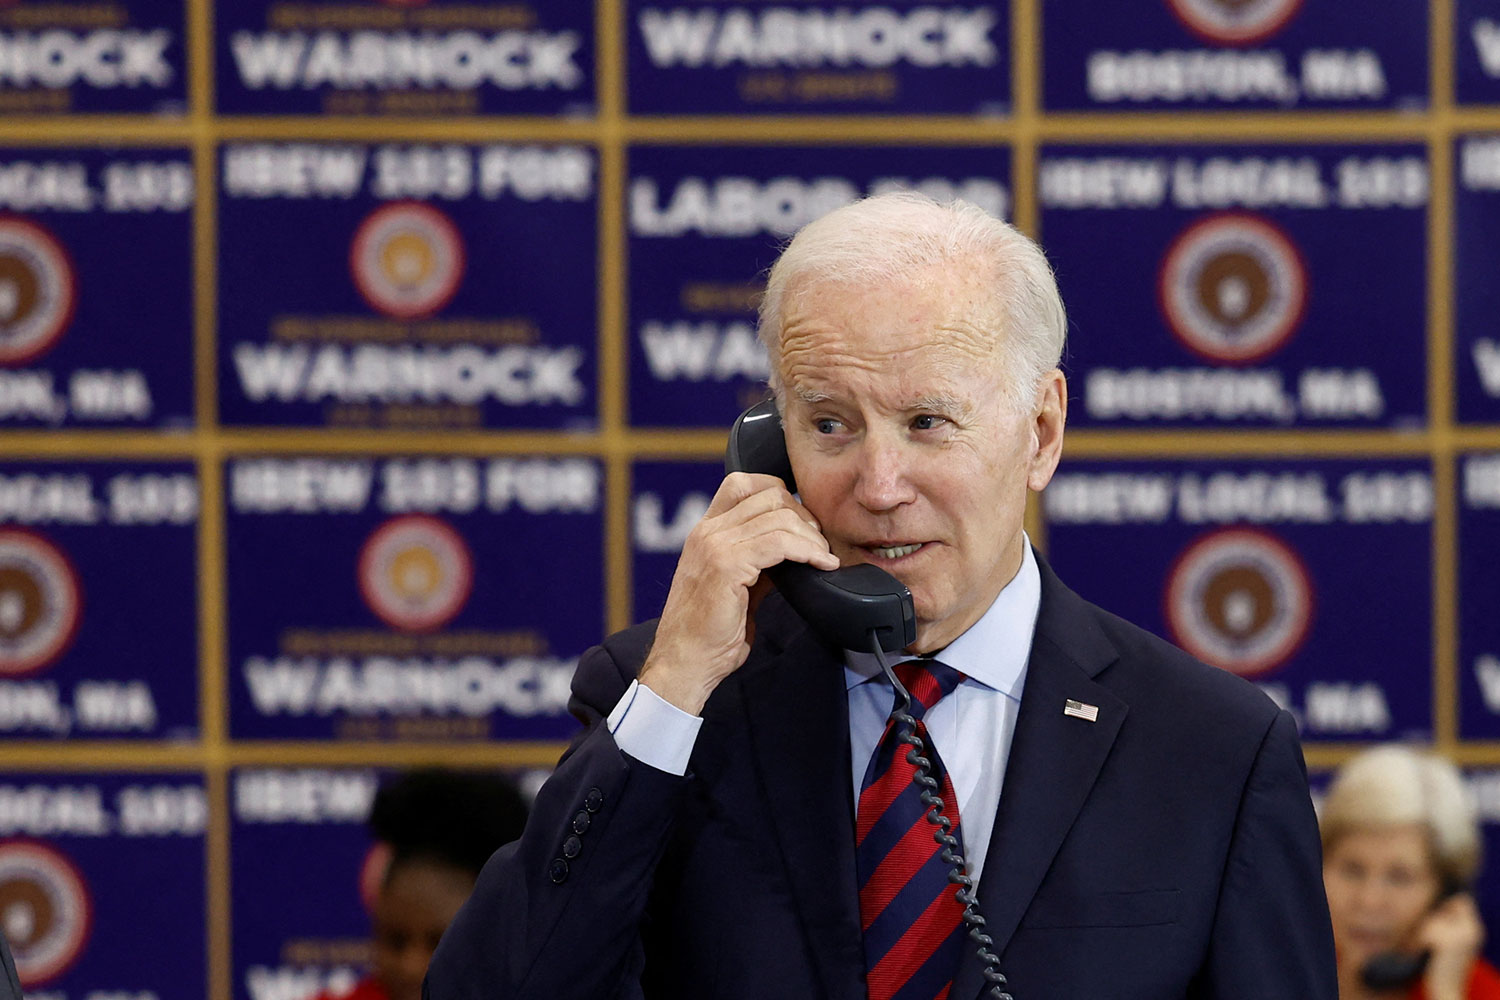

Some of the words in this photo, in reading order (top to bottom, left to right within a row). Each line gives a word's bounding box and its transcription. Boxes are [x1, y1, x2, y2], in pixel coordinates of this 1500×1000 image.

[230, 30, 584, 91] WARNOCK
[641, 8, 995, 67] WARNOCK
[1300, 51, 1387, 100] MA
[224, 146, 366, 197] IBEW
[375, 146, 470, 198] 103
[480, 146, 593, 199] FOR
[1042, 159, 1172, 207] IBEW
[1337, 155, 1428, 207] 103
[69, 368, 150, 420] MA
[235, 342, 582, 403] WARNOCK
[1299, 370, 1382, 417] MA
[231, 460, 373, 512] IBEW
[381, 460, 480, 512] 103
[486, 460, 601, 512] FOR
[1342, 470, 1432, 522] 103
[73, 679, 156, 732] MA
[1303, 680, 1388, 731] MA
